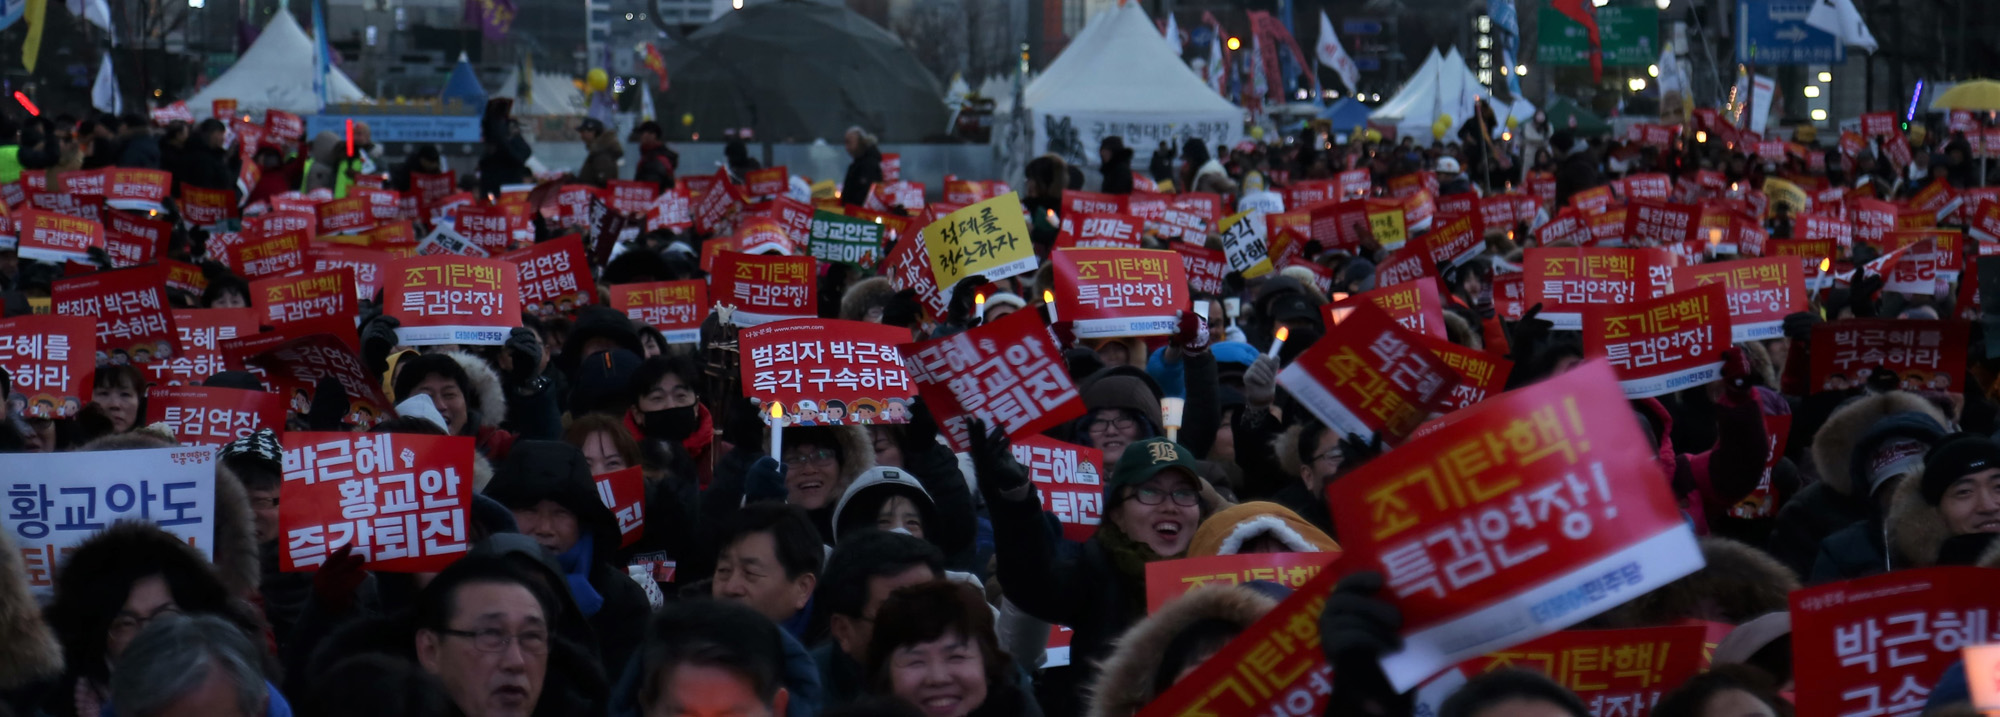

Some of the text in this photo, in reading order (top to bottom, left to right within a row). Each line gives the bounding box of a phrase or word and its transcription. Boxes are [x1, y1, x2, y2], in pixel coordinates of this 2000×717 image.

[112, 183, 163, 199] 특검연장!
[35, 214, 95, 239] 조기탄핵!
[462, 214, 507, 233] 박근혜를
[782, 206, 812, 230] 박근
[1080, 217, 1134, 240] 헌재는
[1637, 205, 1689, 227] 특검연장
[33, 226, 94, 251] 특검연장!
[461, 230, 508, 249] 구속하라
[811, 219, 878, 243] 황교안도
[1221, 216, 1255, 252] 즉각
[1634, 221, 1687, 242] 즉각탄핵
[240, 233, 301, 261] 조기탄핵!
[1229, 241, 1268, 274] 탄핵
[243, 249, 303, 278] 특검연장!
[403, 263, 503, 291] 조기탄핵!
[517, 251, 572, 287] 검연장
[734, 260, 809, 286] 조기탄핵!
[1076, 258, 1170, 283] 조기탄핵!
[1183, 253, 1229, 283] 박근혜
[1543, 255, 1636, 282] 조기탄핵!
[266, 273, 344, 304] 조기탄핵!
[1188, 275, 1225, 299] 속하
[1541, 279, 1636, 305] 특검연장!
[1694, 264, 1790, 293] 조기탄핵!
[56, 294, 104, 319] 범죄자
[104, 286, 162, 315] 박근혜
[267, 293, 345, 324] 특검연장!
[401, 290, 504, 318] 특검연장!
[625, 284, 696, 306] 조기탄핵!
[732, 283, 809, 309] 특검연장!
[1076, 282, 1173, 310] 특검연장!
[1371, 287, 1421, 313] 탄핵!
[96, 312, 169, 345] 구속하라
[627, 304, 698, 325] 특검연장!
[1130, 320, 1175, 333] 더불어민주당
[1603, 294, 1710, 341] 조기탄핵!
[455, 330, 503, 342] 더불어민주당
[773, 324, 825, 335] www.nanum.com
[1747, 327, 1784, 340] 더불어민주
[1833, 328, 1943, 350] 박근혜를
[751, 340, 906, 368] 범죄자 박근혜
[904, 333, 983, 386] 박근혜
[1605, 324, 1714, 370] 특검연장!
[1832, 347, 1943, 370] 구속하라
[1, 363, 71, 394] 하라
[753, 367, 911, 394] 즉각 구속하라
[946, 334, 1054, 413] 황교안
[1369, 329, 1447, 404] 박근혜
[163, 408, 262, 441] 특검연장
[282, 432, 395, 485] 박근혜
[1011, 444, 1079, 485] 박근혜
[1146, 441, 1180, 469] B
[1365, 395, 1592, 542] 조기탄핵!
[338, 467, 461, 520] 황교안
[7, 480, 204, 540] 황교안도
[287, 508, 468, 569] 즉각퇴진
[1380, 461, 1619, 601] 특검연장!
[1529, 560, 1645, 623] 더불어민주당
[1834, 607, 2000, 676] 박근혜
[1840, 674, 1932, 717] 구속
